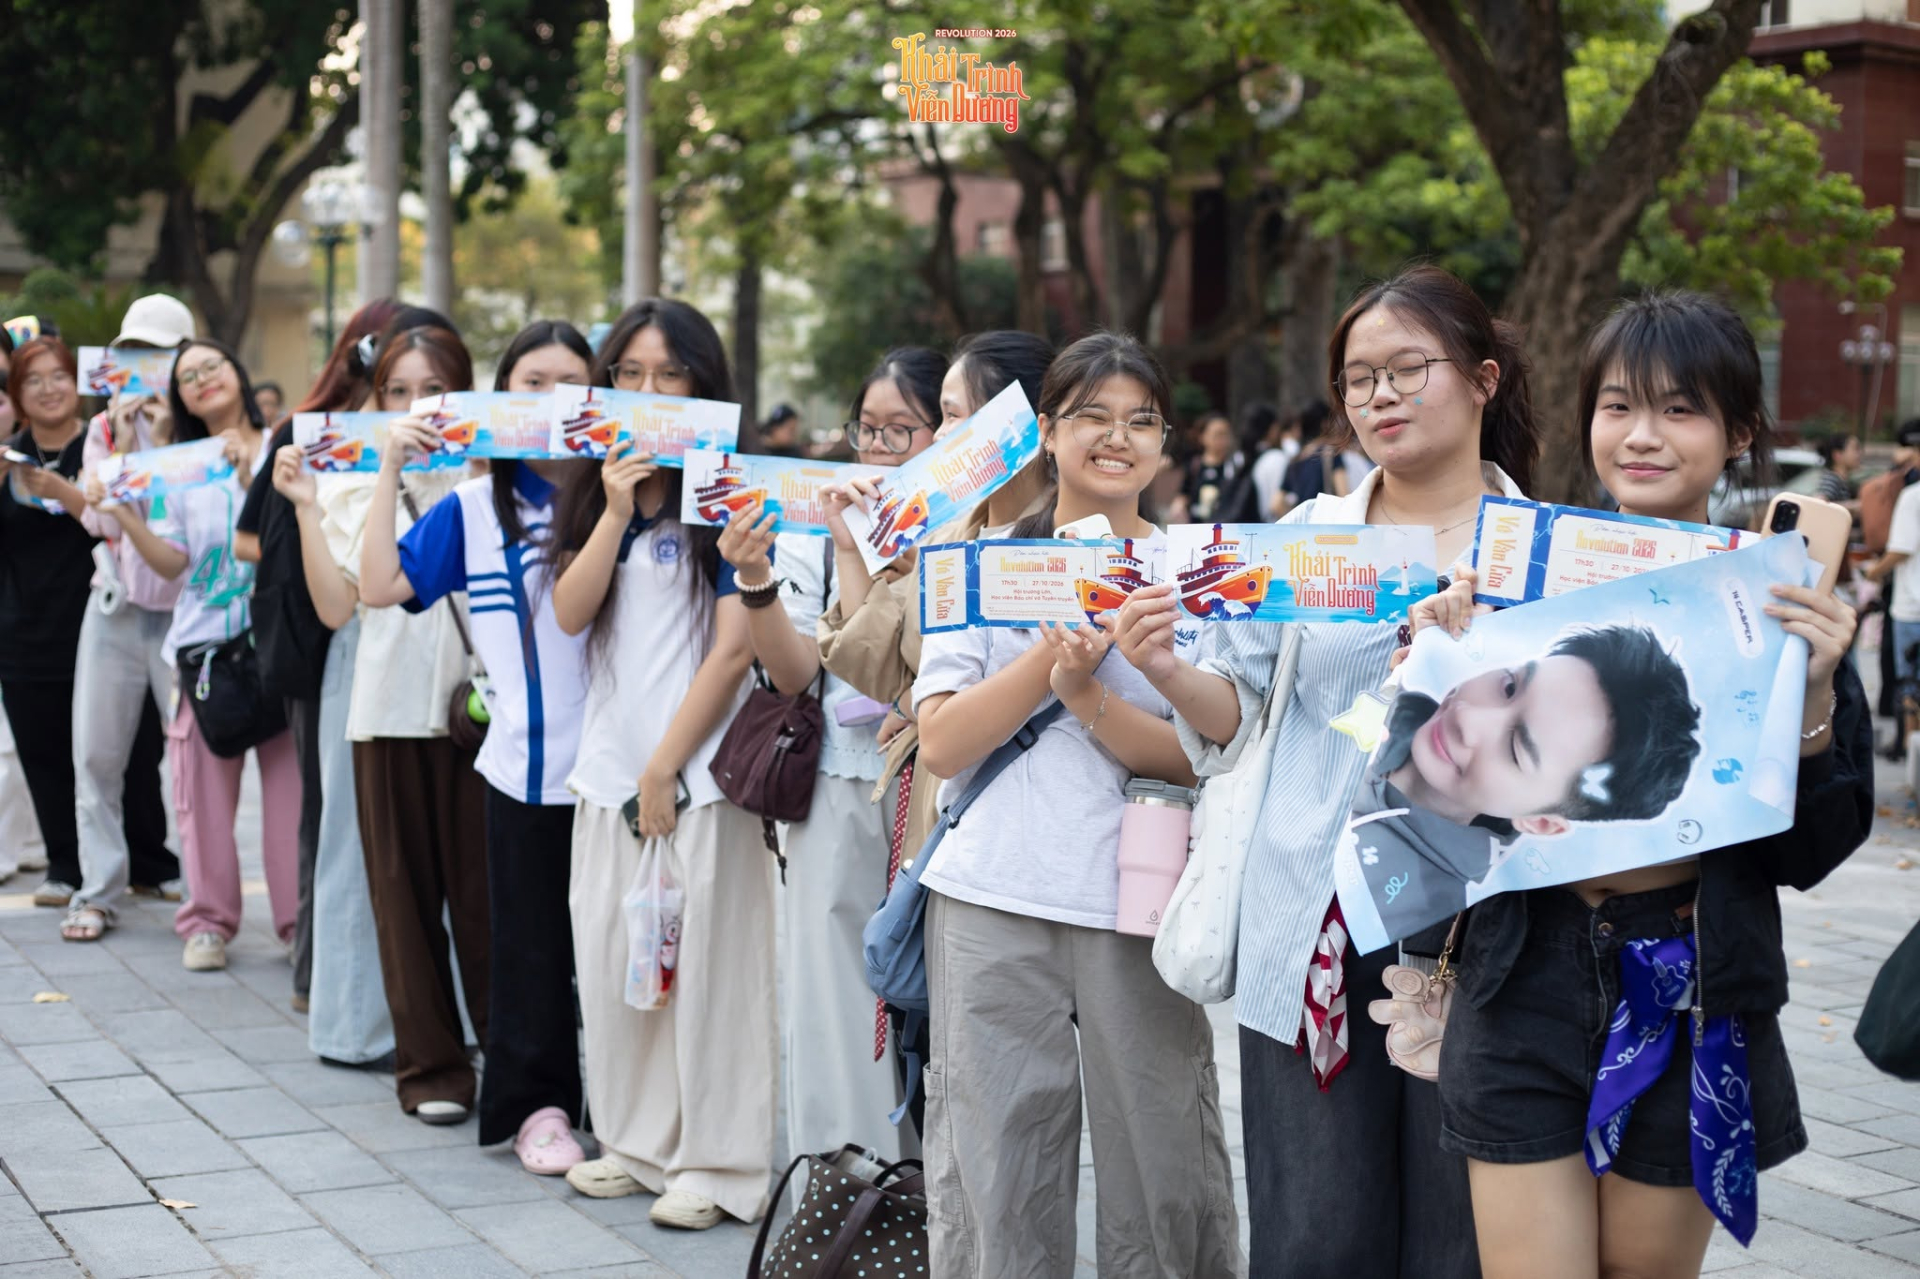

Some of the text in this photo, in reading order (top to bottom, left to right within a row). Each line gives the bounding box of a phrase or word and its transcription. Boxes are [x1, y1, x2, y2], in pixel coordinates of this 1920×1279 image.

[1283, 540, 1382, 591] Khải Trình
[1287, 578, 1375, 616] Viễn Dương
[1735, 600, 1754, 644] CASPER
